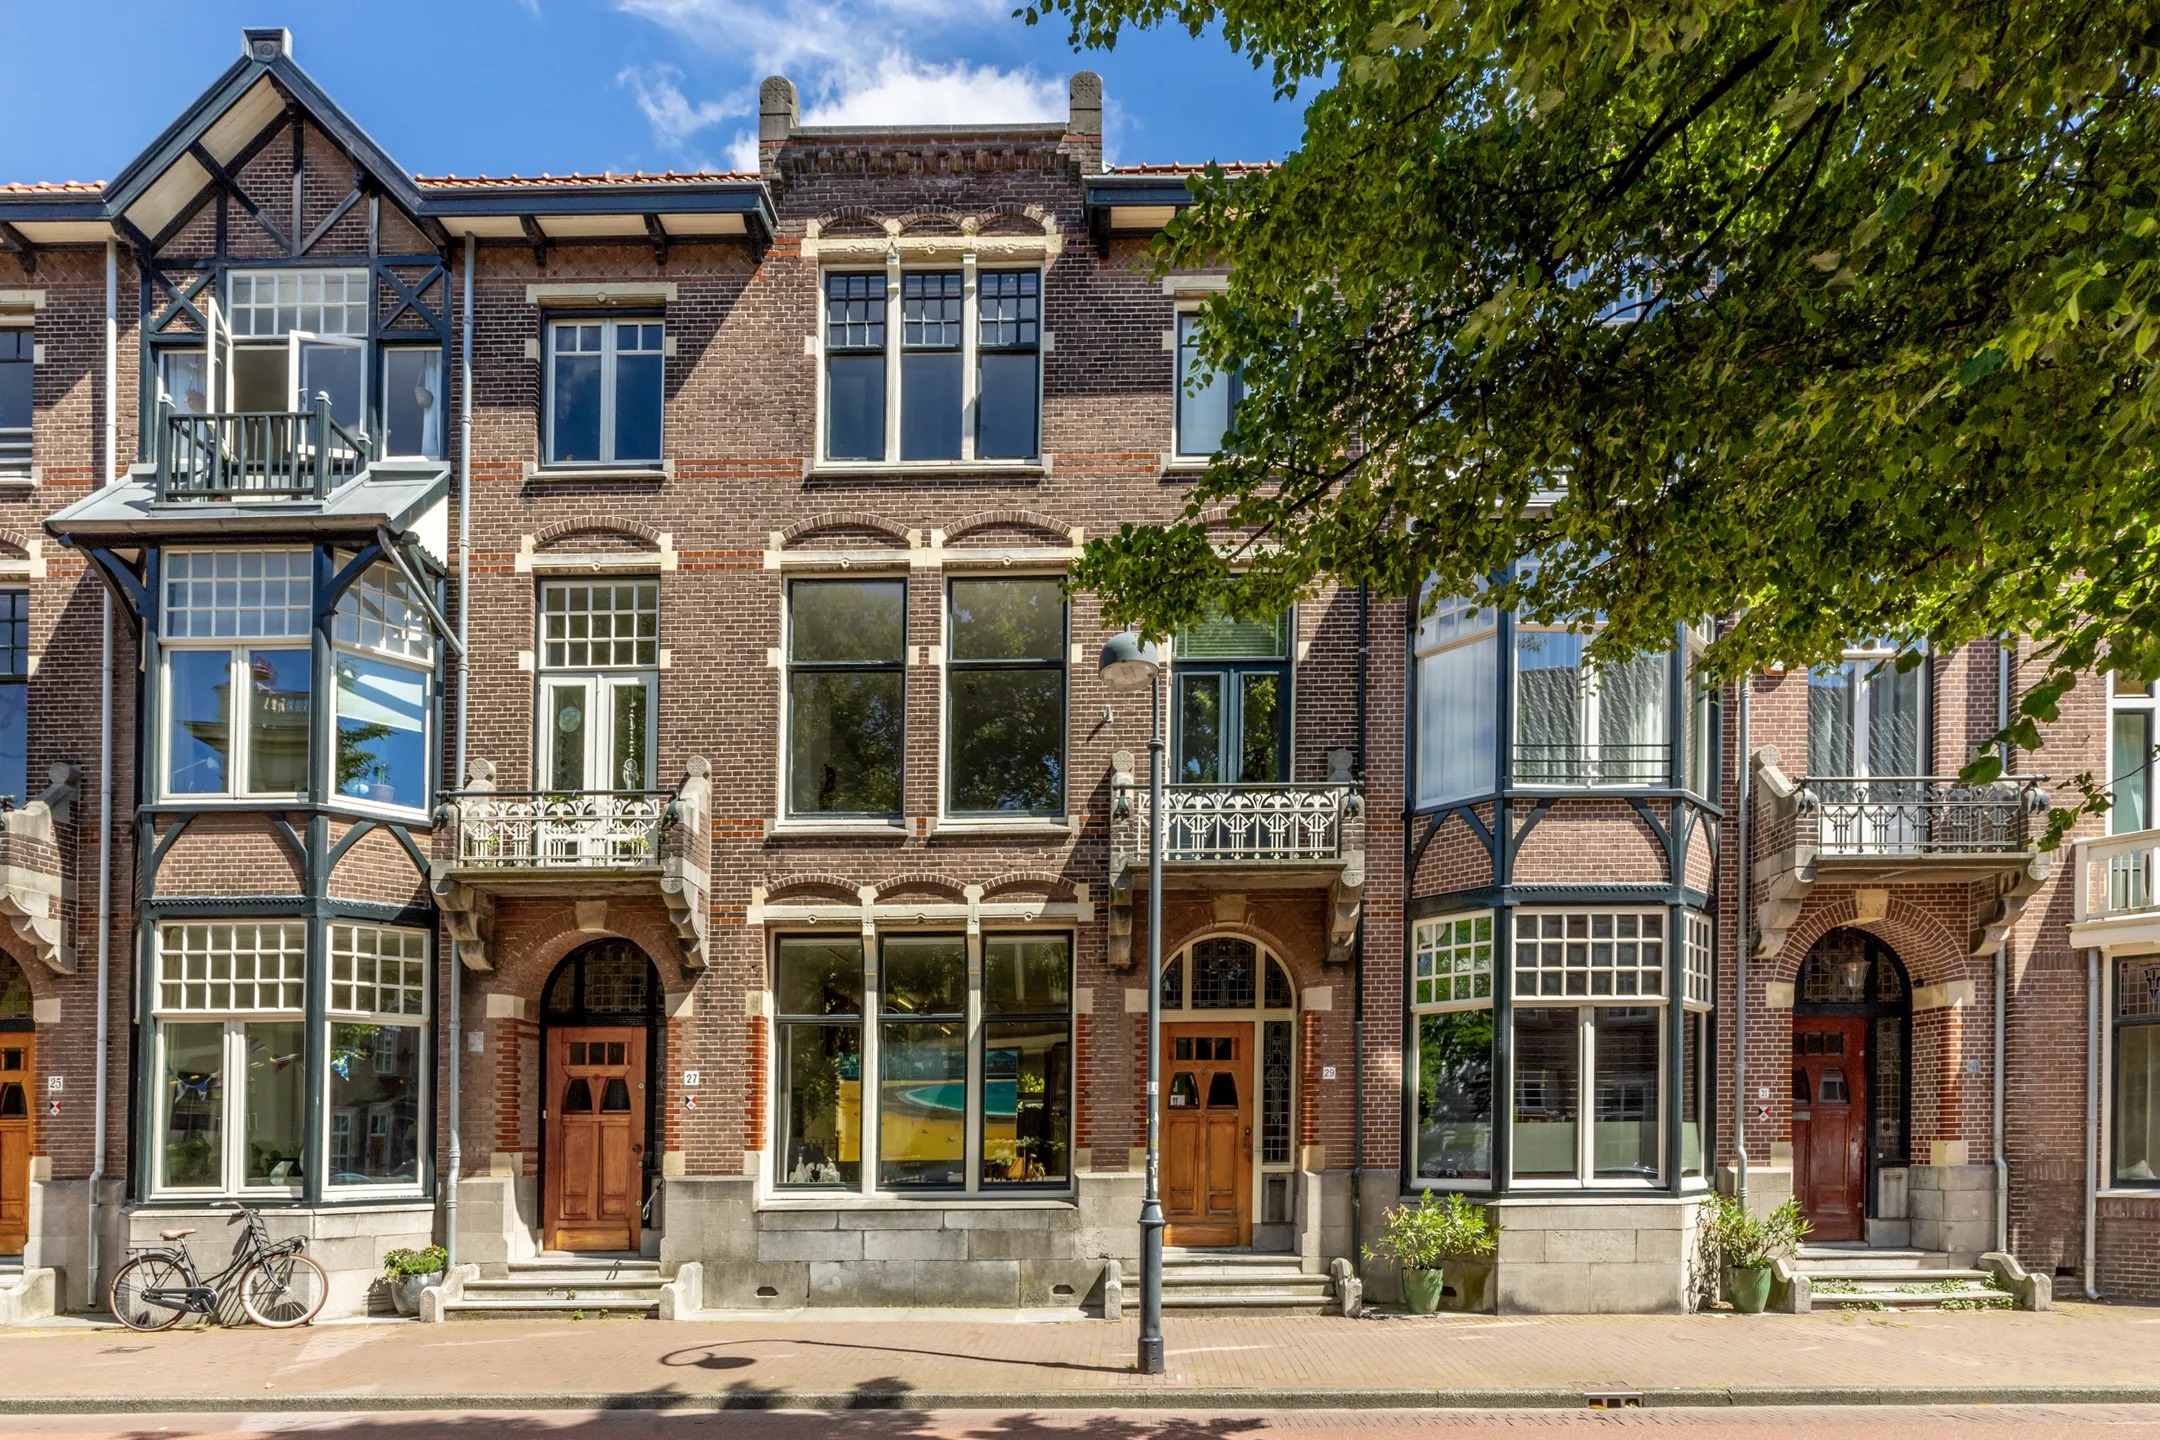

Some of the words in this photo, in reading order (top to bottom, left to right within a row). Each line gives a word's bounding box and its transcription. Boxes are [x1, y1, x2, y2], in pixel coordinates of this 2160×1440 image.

[686, 1073, 698, 1084] 27
[1324, 1068, 1335, 1078] 29
[50, 1077, 62, 1089] 25
